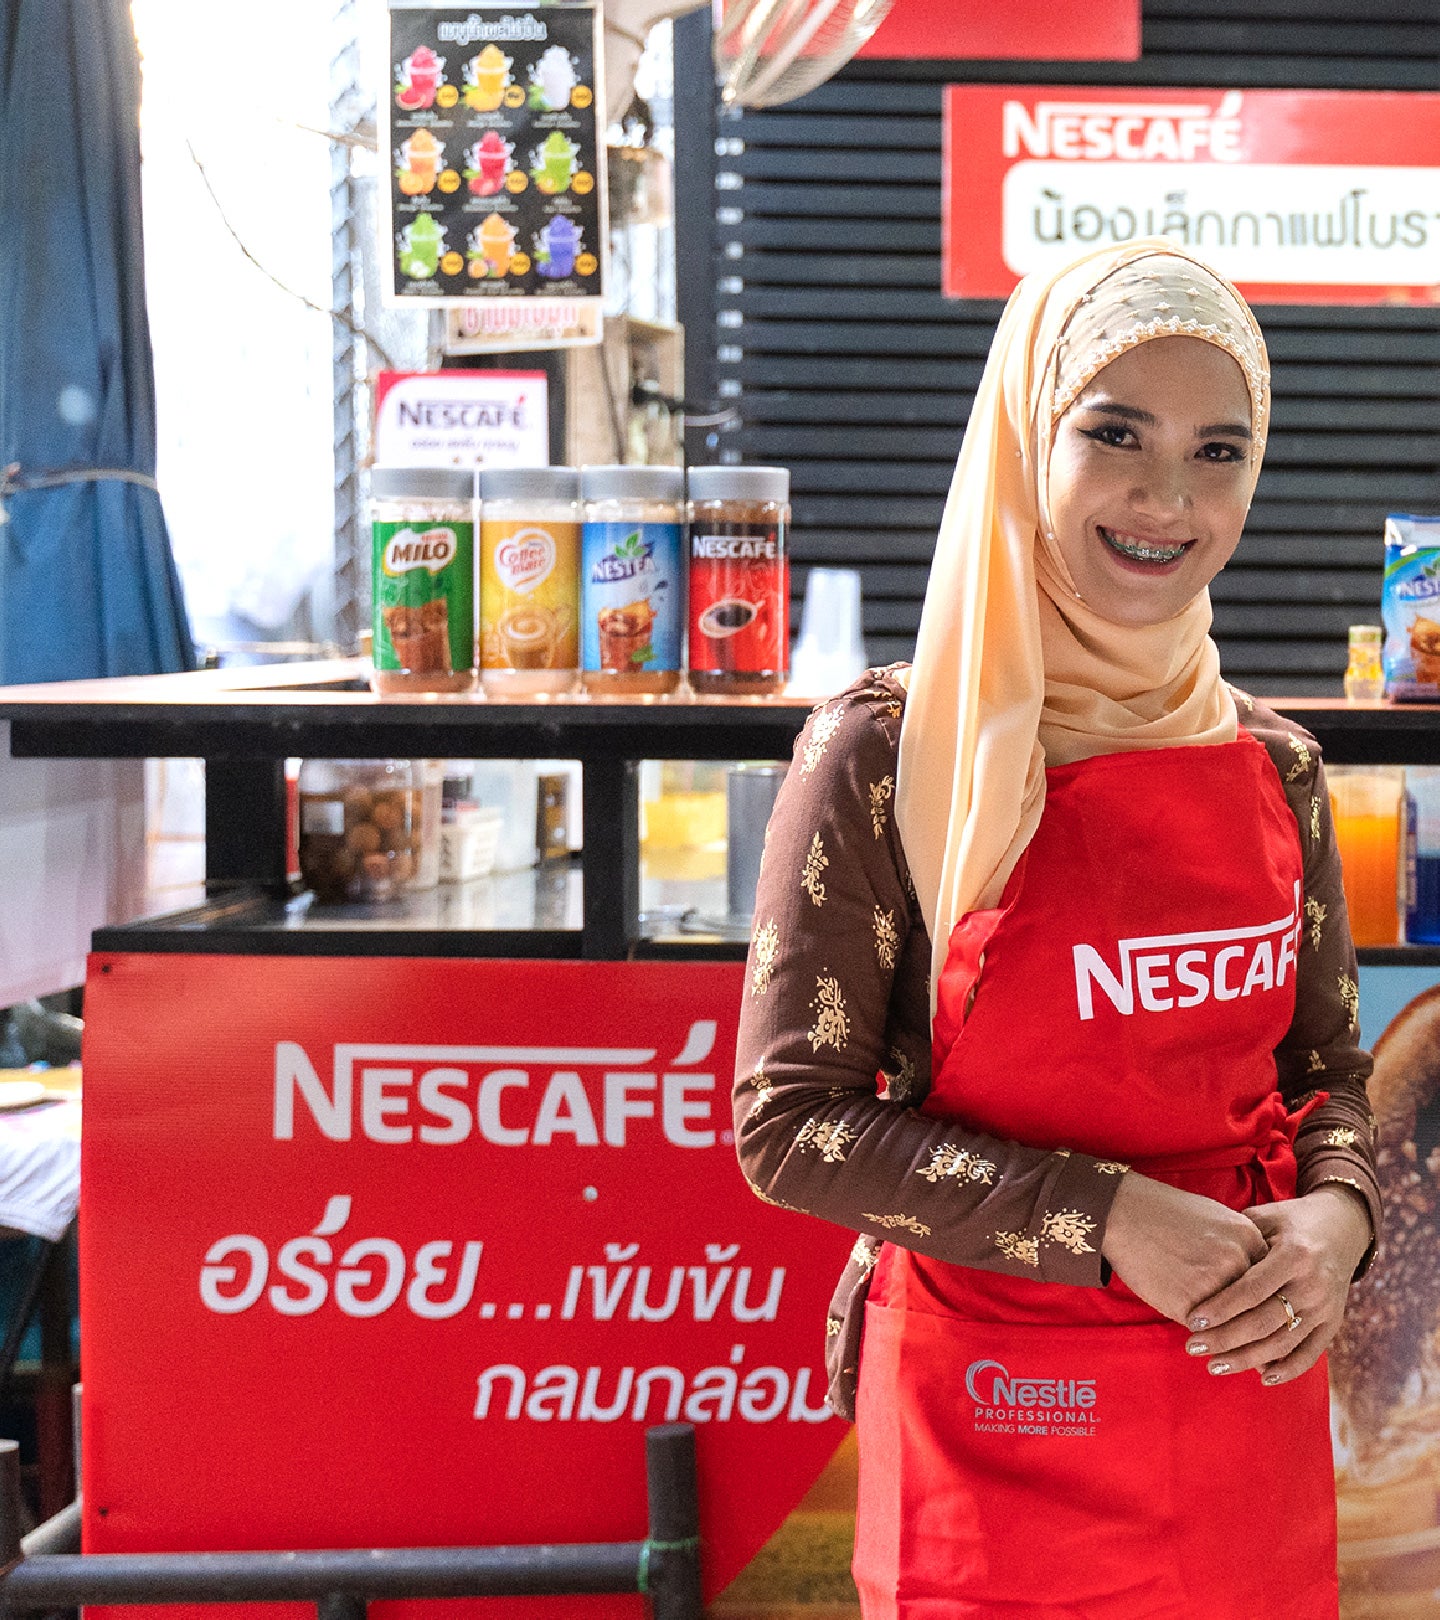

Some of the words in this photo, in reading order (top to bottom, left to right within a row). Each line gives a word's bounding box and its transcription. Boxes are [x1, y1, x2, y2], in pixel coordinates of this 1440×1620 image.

[1003, 90, 1244, 162] NESCAFÉ
[397, 395, 526, 430] NESCAFÉ
[391, 542, 450, 565] MILO
[499, 543, 546, 568] Coffee
[693, 532, 777, 559] NESCAFÉ
[273, 1021, 716, 1147] NESCAFÉ
[473, 1344, 834, 1424] กลมกล่อม
[992, 1377, 1097, 1408] Nestlé
[974, 1407, 1097, 1423] PROFESSIONAL
[974, 1423, 1016, 1434] MAKING
[1018, 1424, 1048, 1436] MORE
[1051, 1426, 1097, 1437] POSSIBLE
